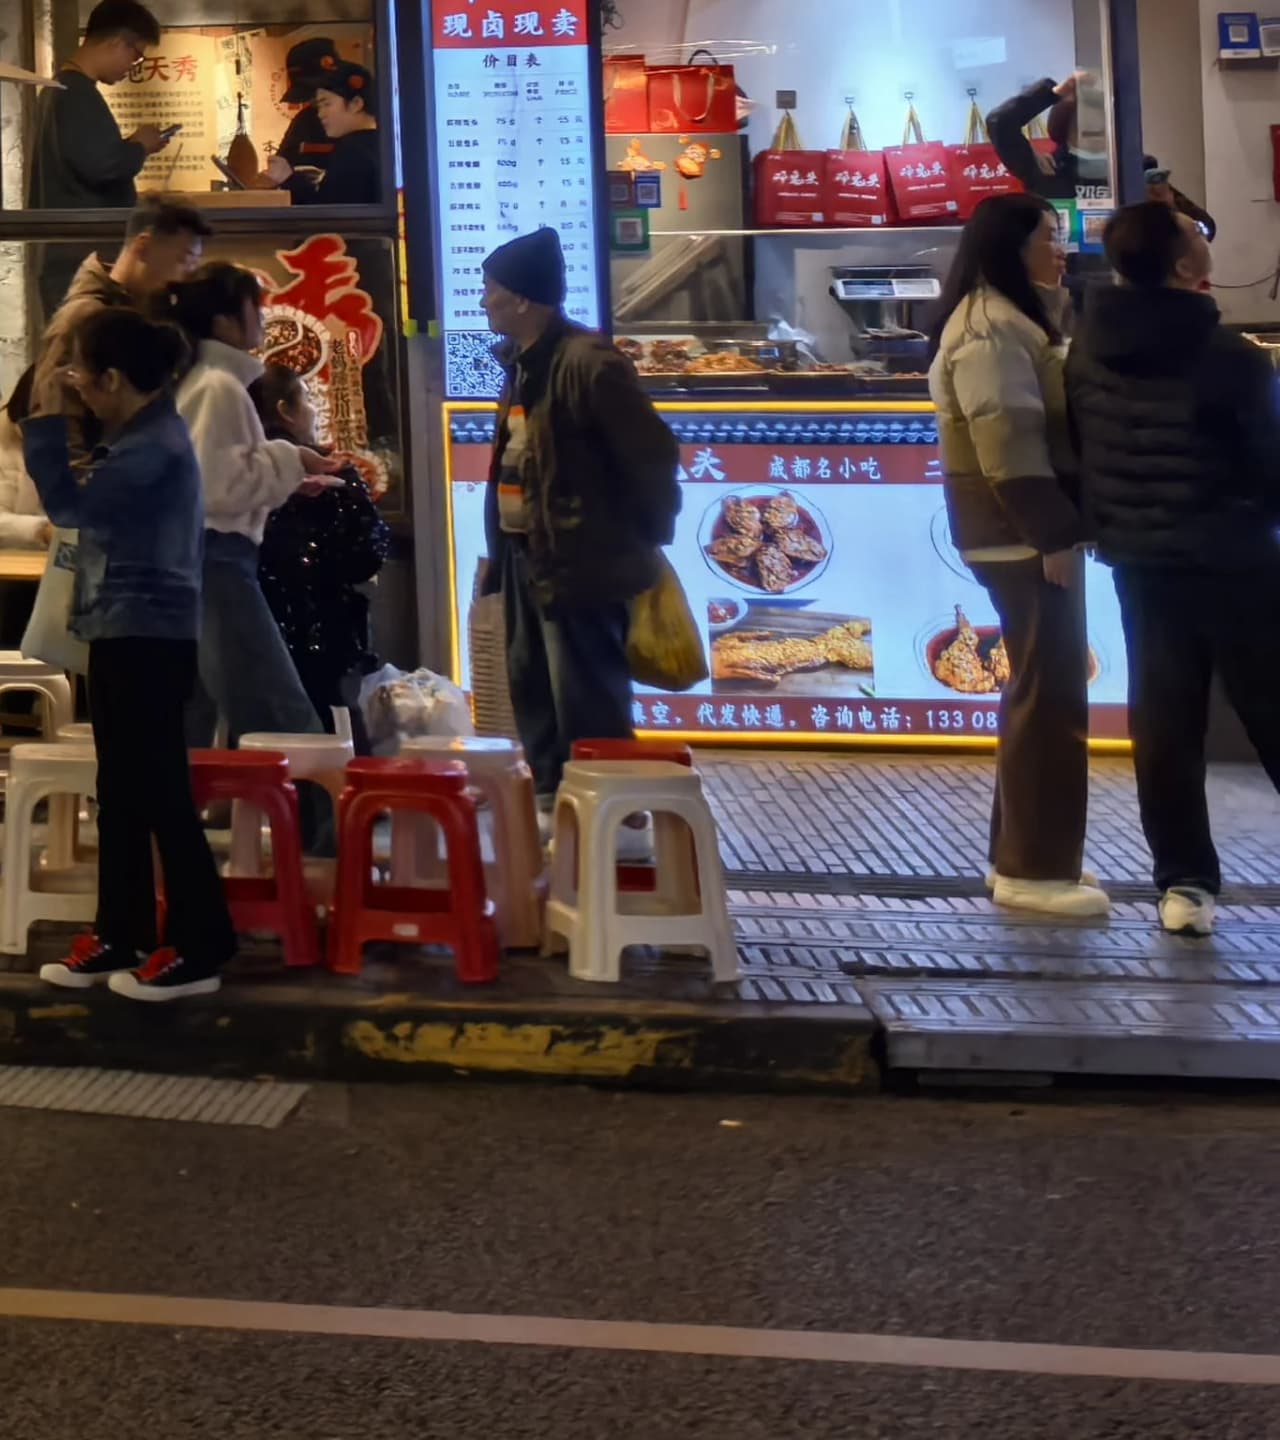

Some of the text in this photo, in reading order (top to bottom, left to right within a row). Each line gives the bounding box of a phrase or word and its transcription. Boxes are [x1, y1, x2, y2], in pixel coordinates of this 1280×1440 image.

[443, 8, 578, 39] 现卤现卖
[482, 52, 542, 68] 价目表
[768, 455, 881, 480] 成都名小吃
